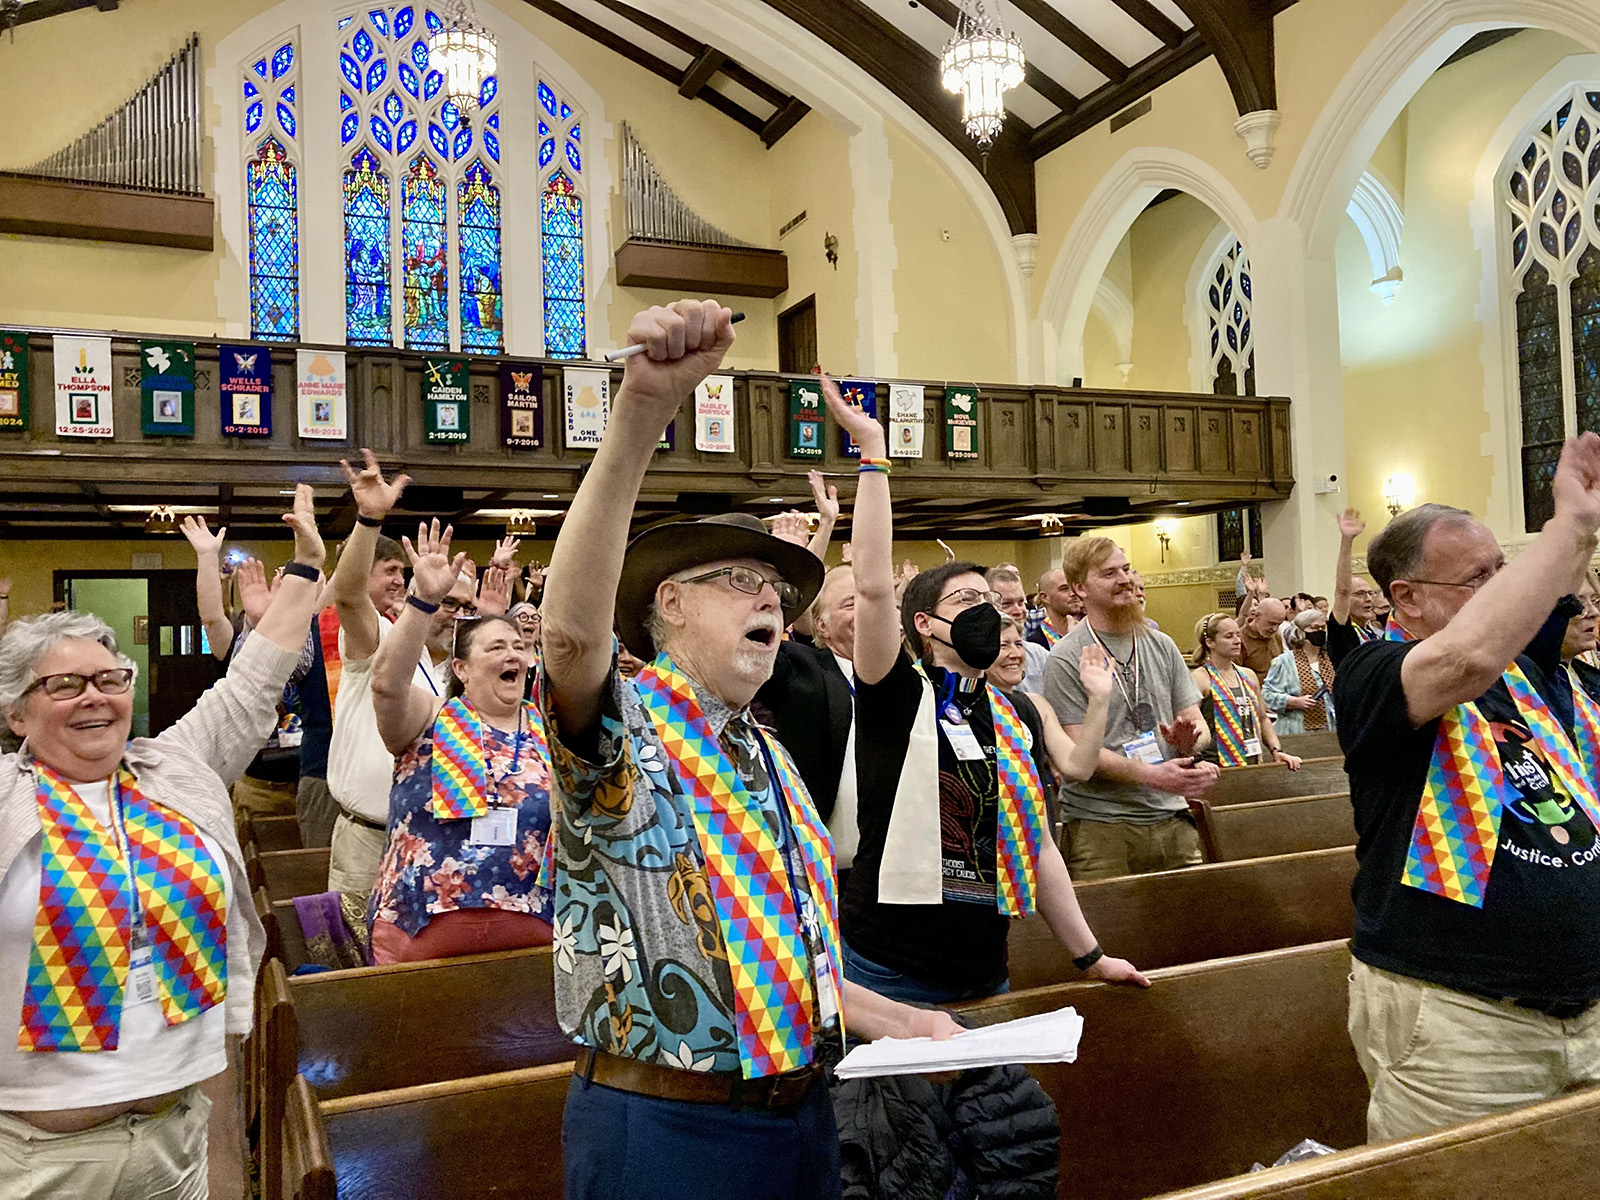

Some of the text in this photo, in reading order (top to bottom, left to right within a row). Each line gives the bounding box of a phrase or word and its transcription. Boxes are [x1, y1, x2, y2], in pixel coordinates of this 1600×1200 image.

[71, 376, 96, 384] ELLA
[229, 377, 261, 385] WELLS
[57, 383, 110, 391] THOMPSON
[221, 383, 269, 393] SCHRADER
[431, 386, 462, 394] CAIDEN
[427, 393, 467, 401] HAMILTON
[507, 393, 537, 402] SAILOR
[507, 400, 538, 409] MARTIN
[1501, 838, 1569, 868] Justice.
